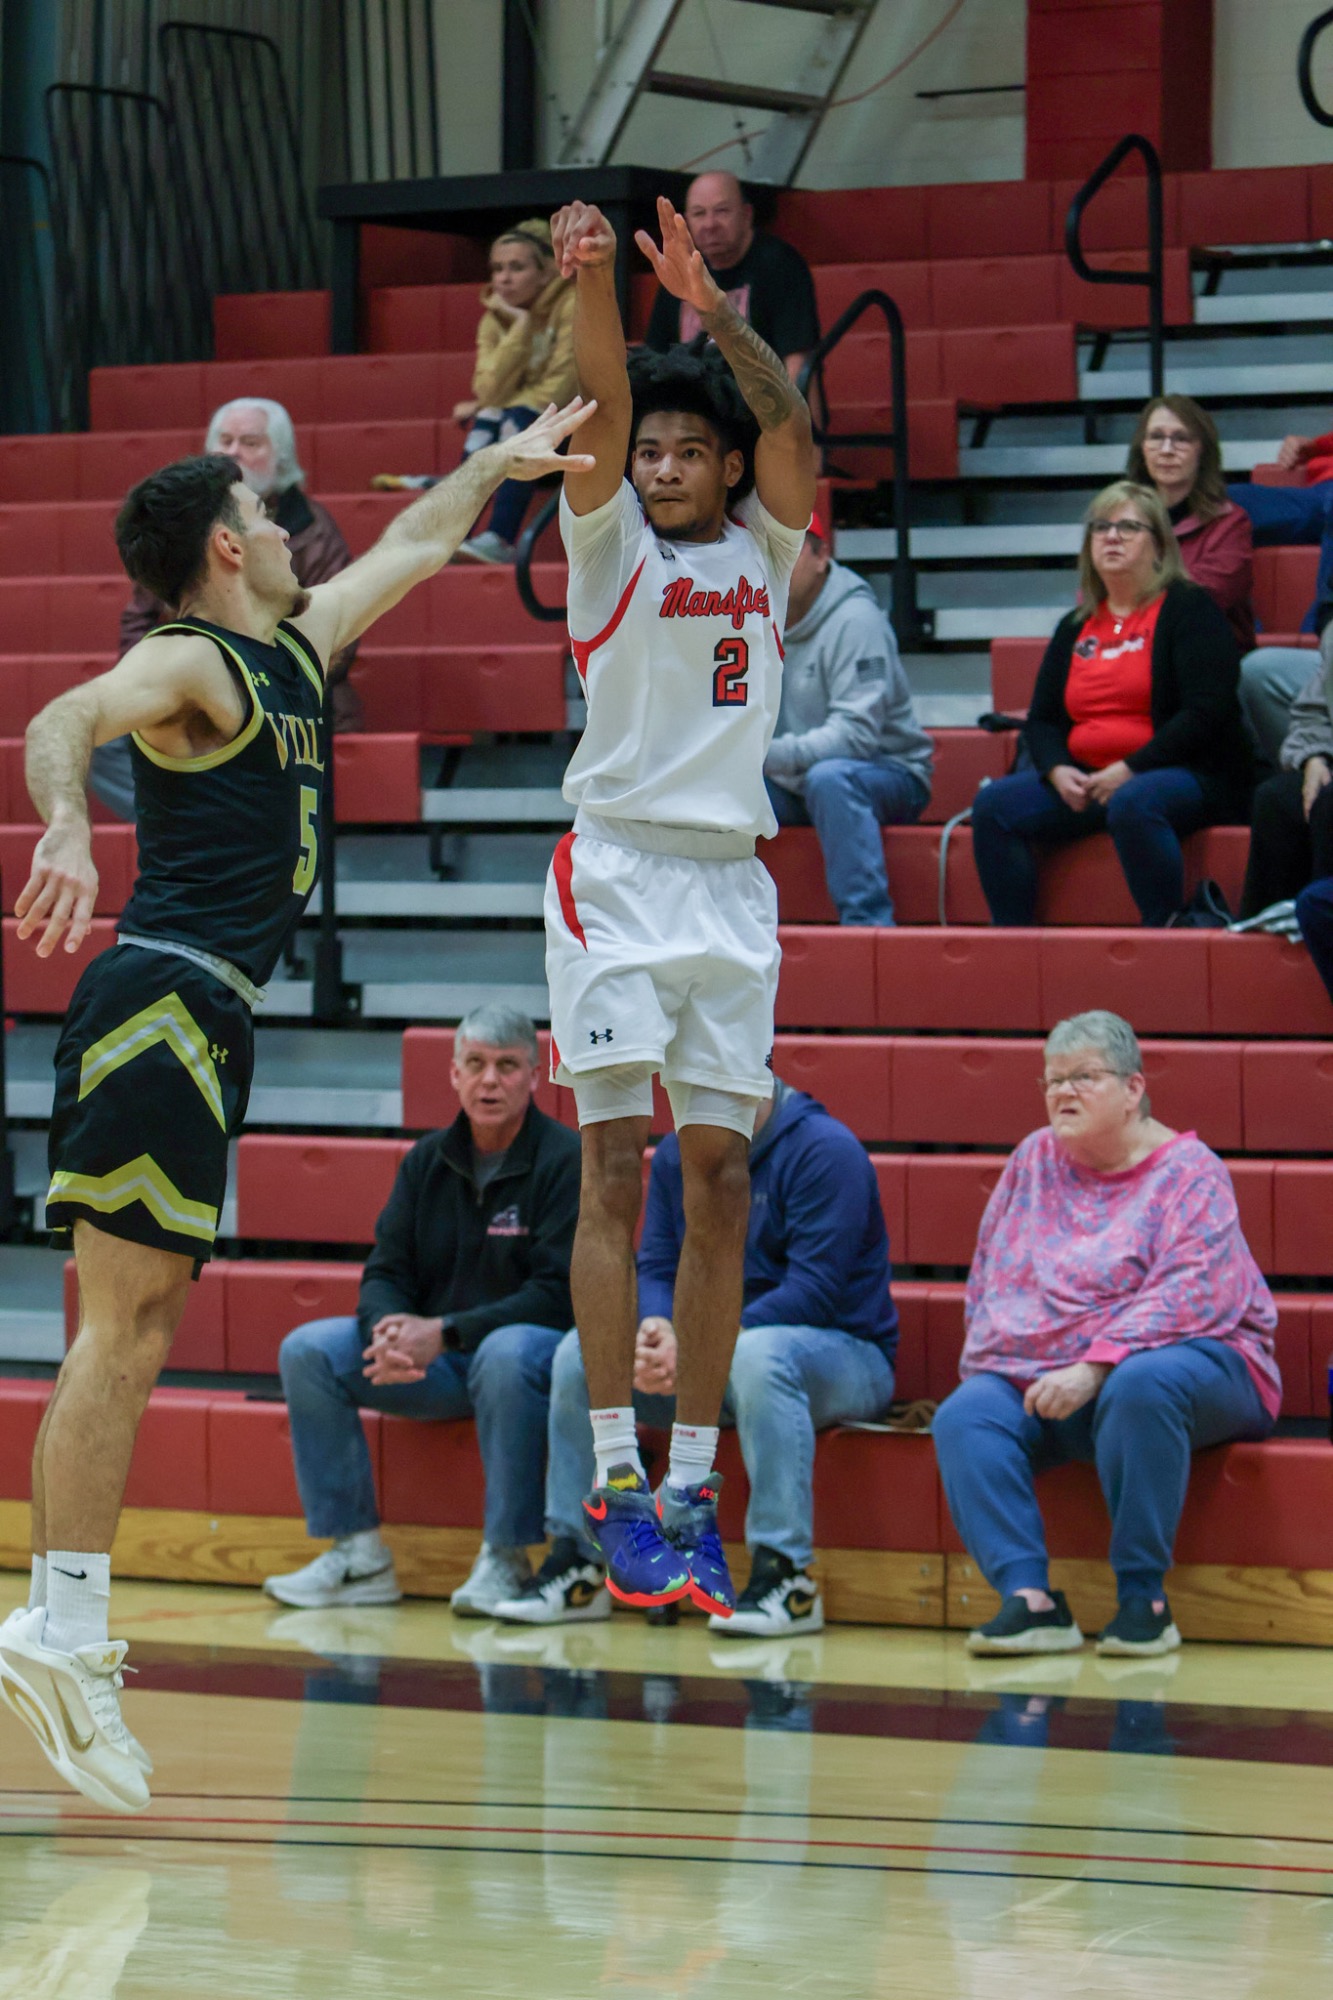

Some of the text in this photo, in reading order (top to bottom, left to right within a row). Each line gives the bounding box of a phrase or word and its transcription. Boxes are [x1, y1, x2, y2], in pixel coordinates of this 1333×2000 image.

[712, 637, 748, 707] 2
[264, 711, 325, 772] VILL
[292, 784, 318, 896] 5
